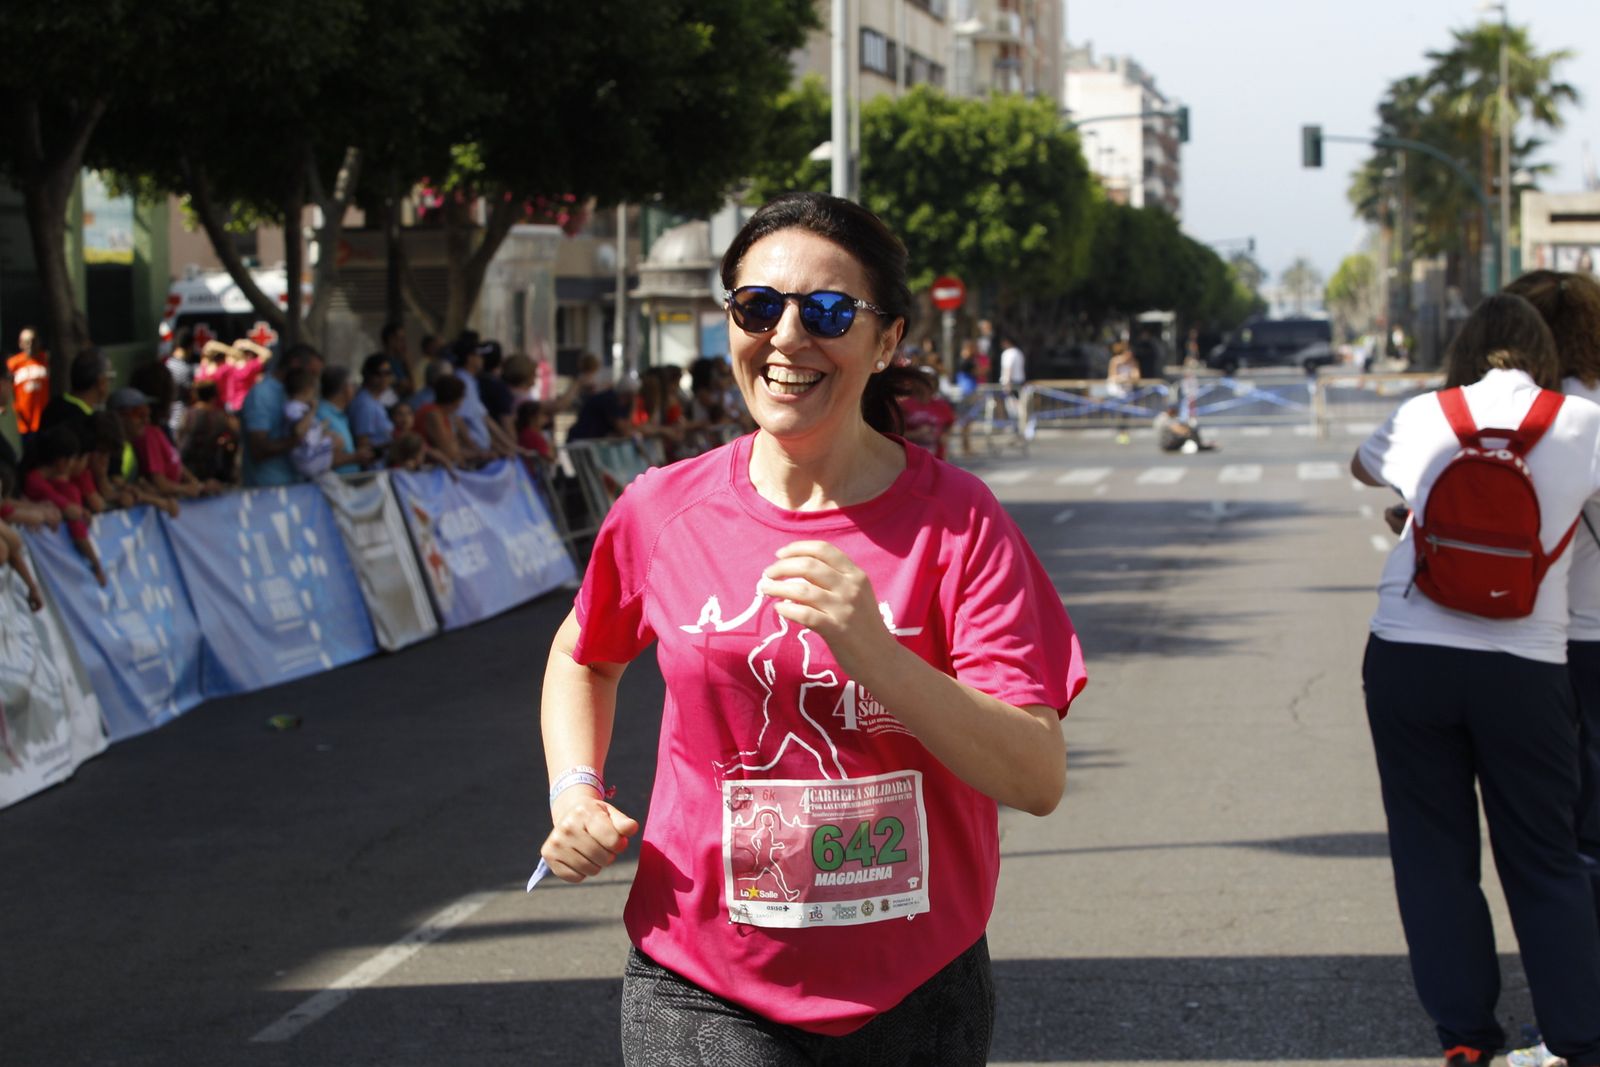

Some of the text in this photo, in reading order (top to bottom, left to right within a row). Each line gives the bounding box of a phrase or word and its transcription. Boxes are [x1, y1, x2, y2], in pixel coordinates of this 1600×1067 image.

[832, 680, 861, 731] 4
[799, 787, 812, 814] 4
[810, 786, 863, 803] CARRERA
[863, 779, 912, 798] SOLIDARIA
[811, 816, 907, 872] 642
[740, 888, 778, 899] La Salle
[814, 865, 893, 887] MAGDALENA
